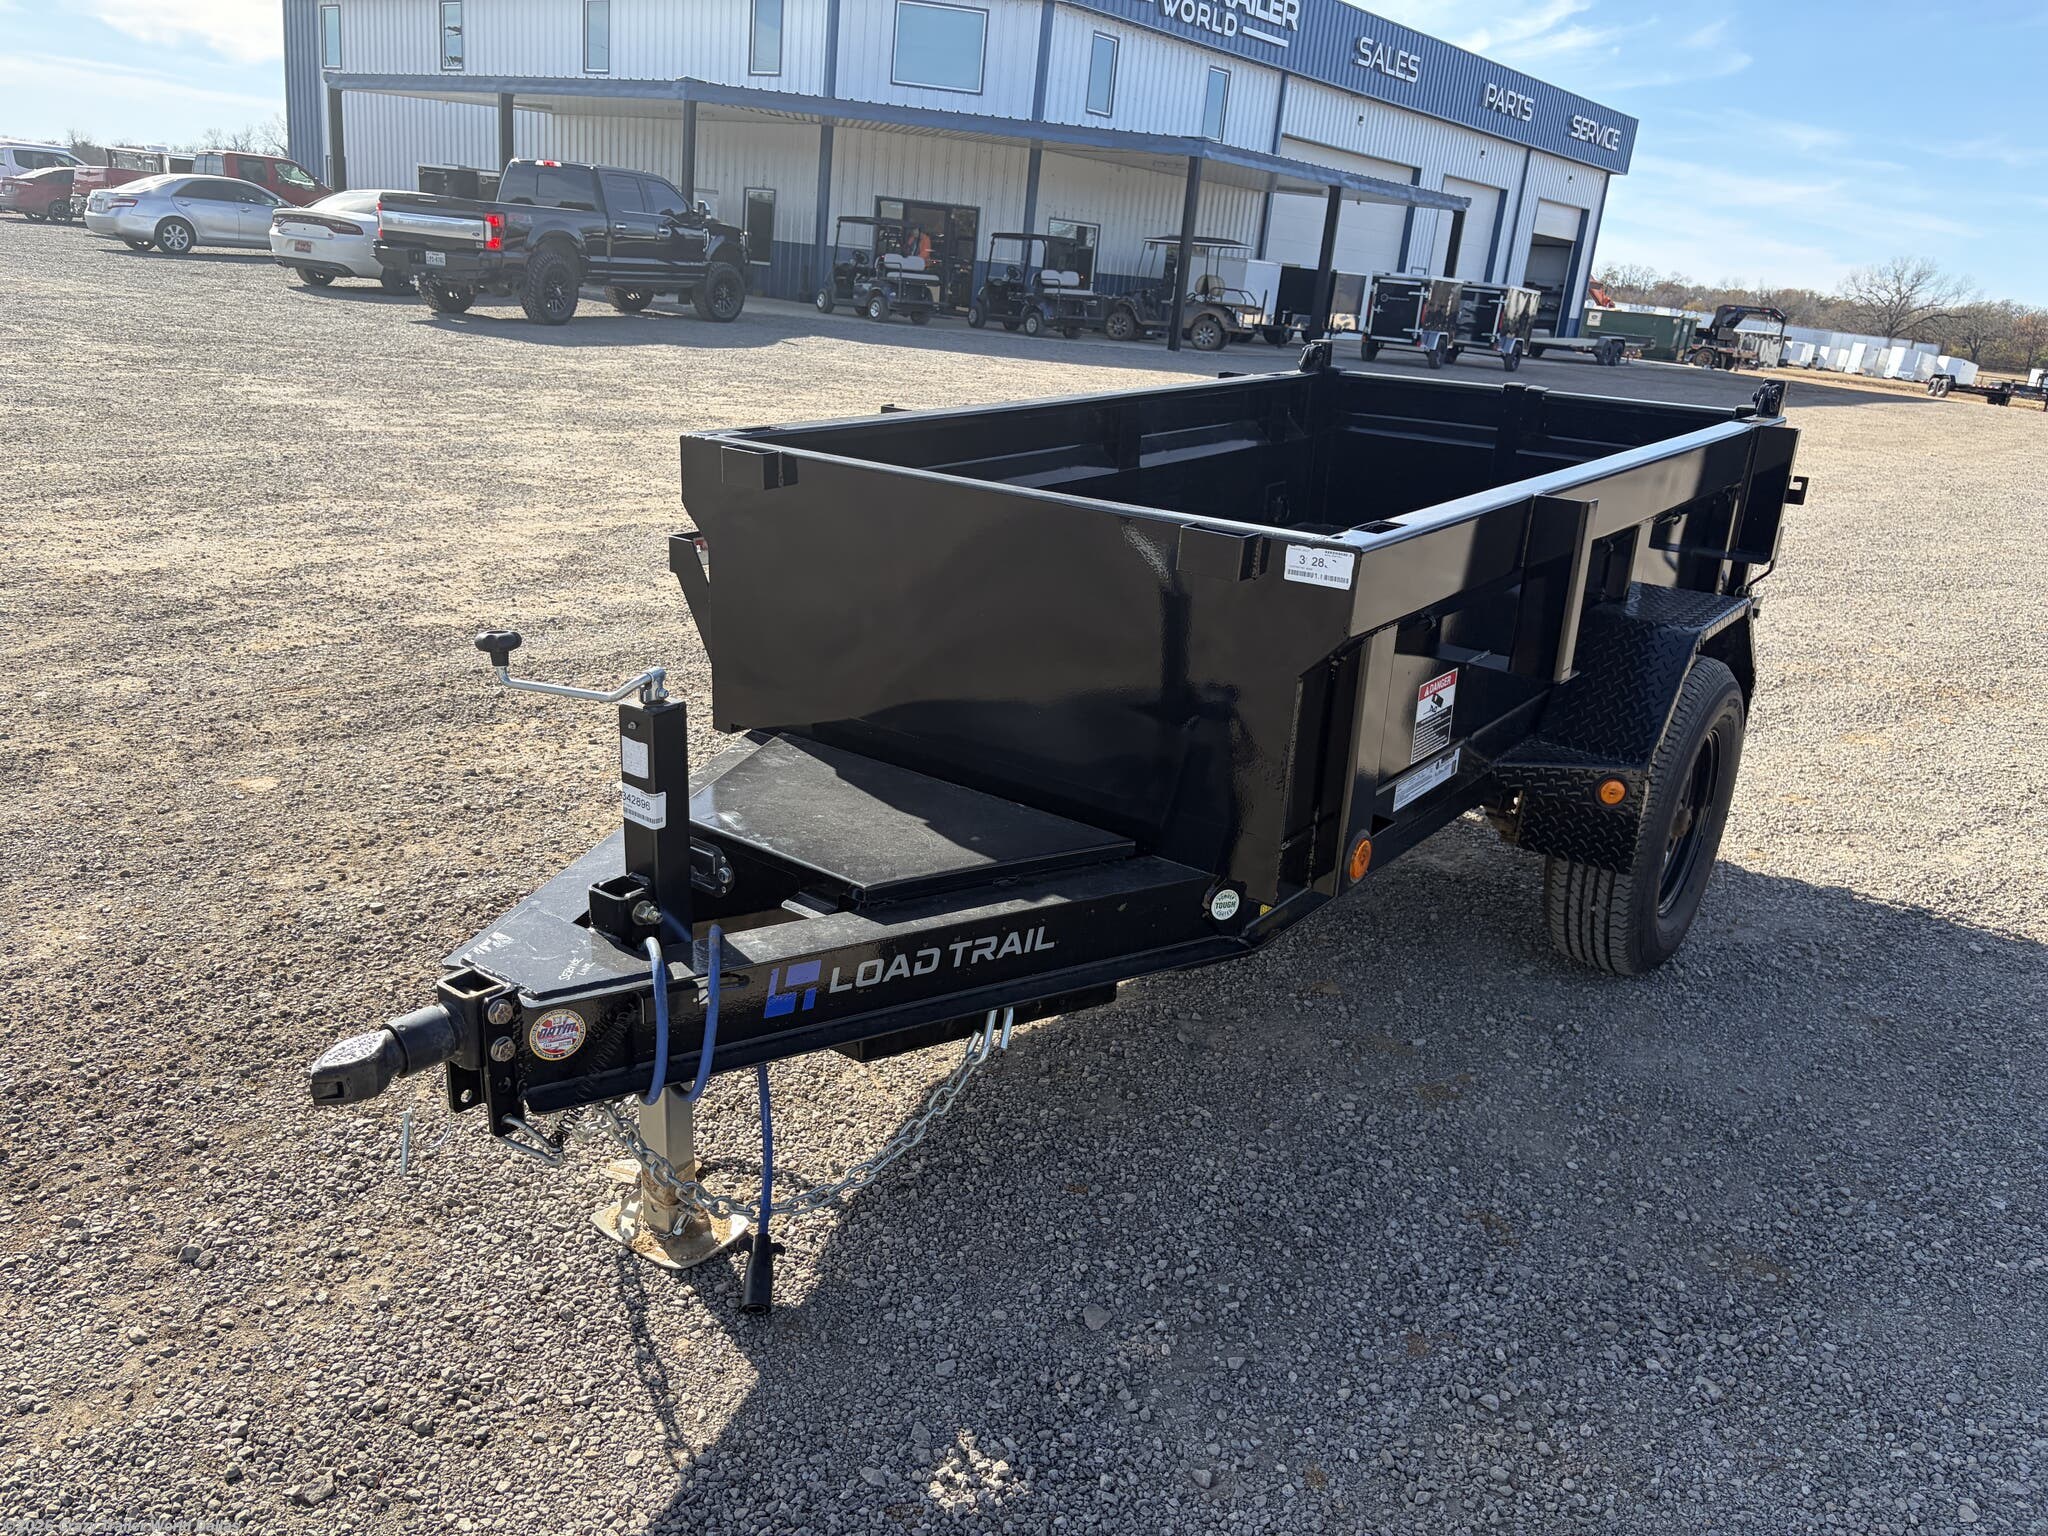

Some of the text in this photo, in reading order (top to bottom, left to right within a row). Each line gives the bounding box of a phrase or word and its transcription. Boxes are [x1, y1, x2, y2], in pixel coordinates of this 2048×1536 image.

[1162, 0, 1238, 37] WORLD
[1357, 36, 1421, 83] SALES
[1484, 82, 1535, 122] PARTS
[1570, 114, 1621, 151] SERVICE
[1429, 674, 1452, 694] DANGER
[829, 947, 941, 994] LOAD
[949, 926, 1056, 968] TRAIL
